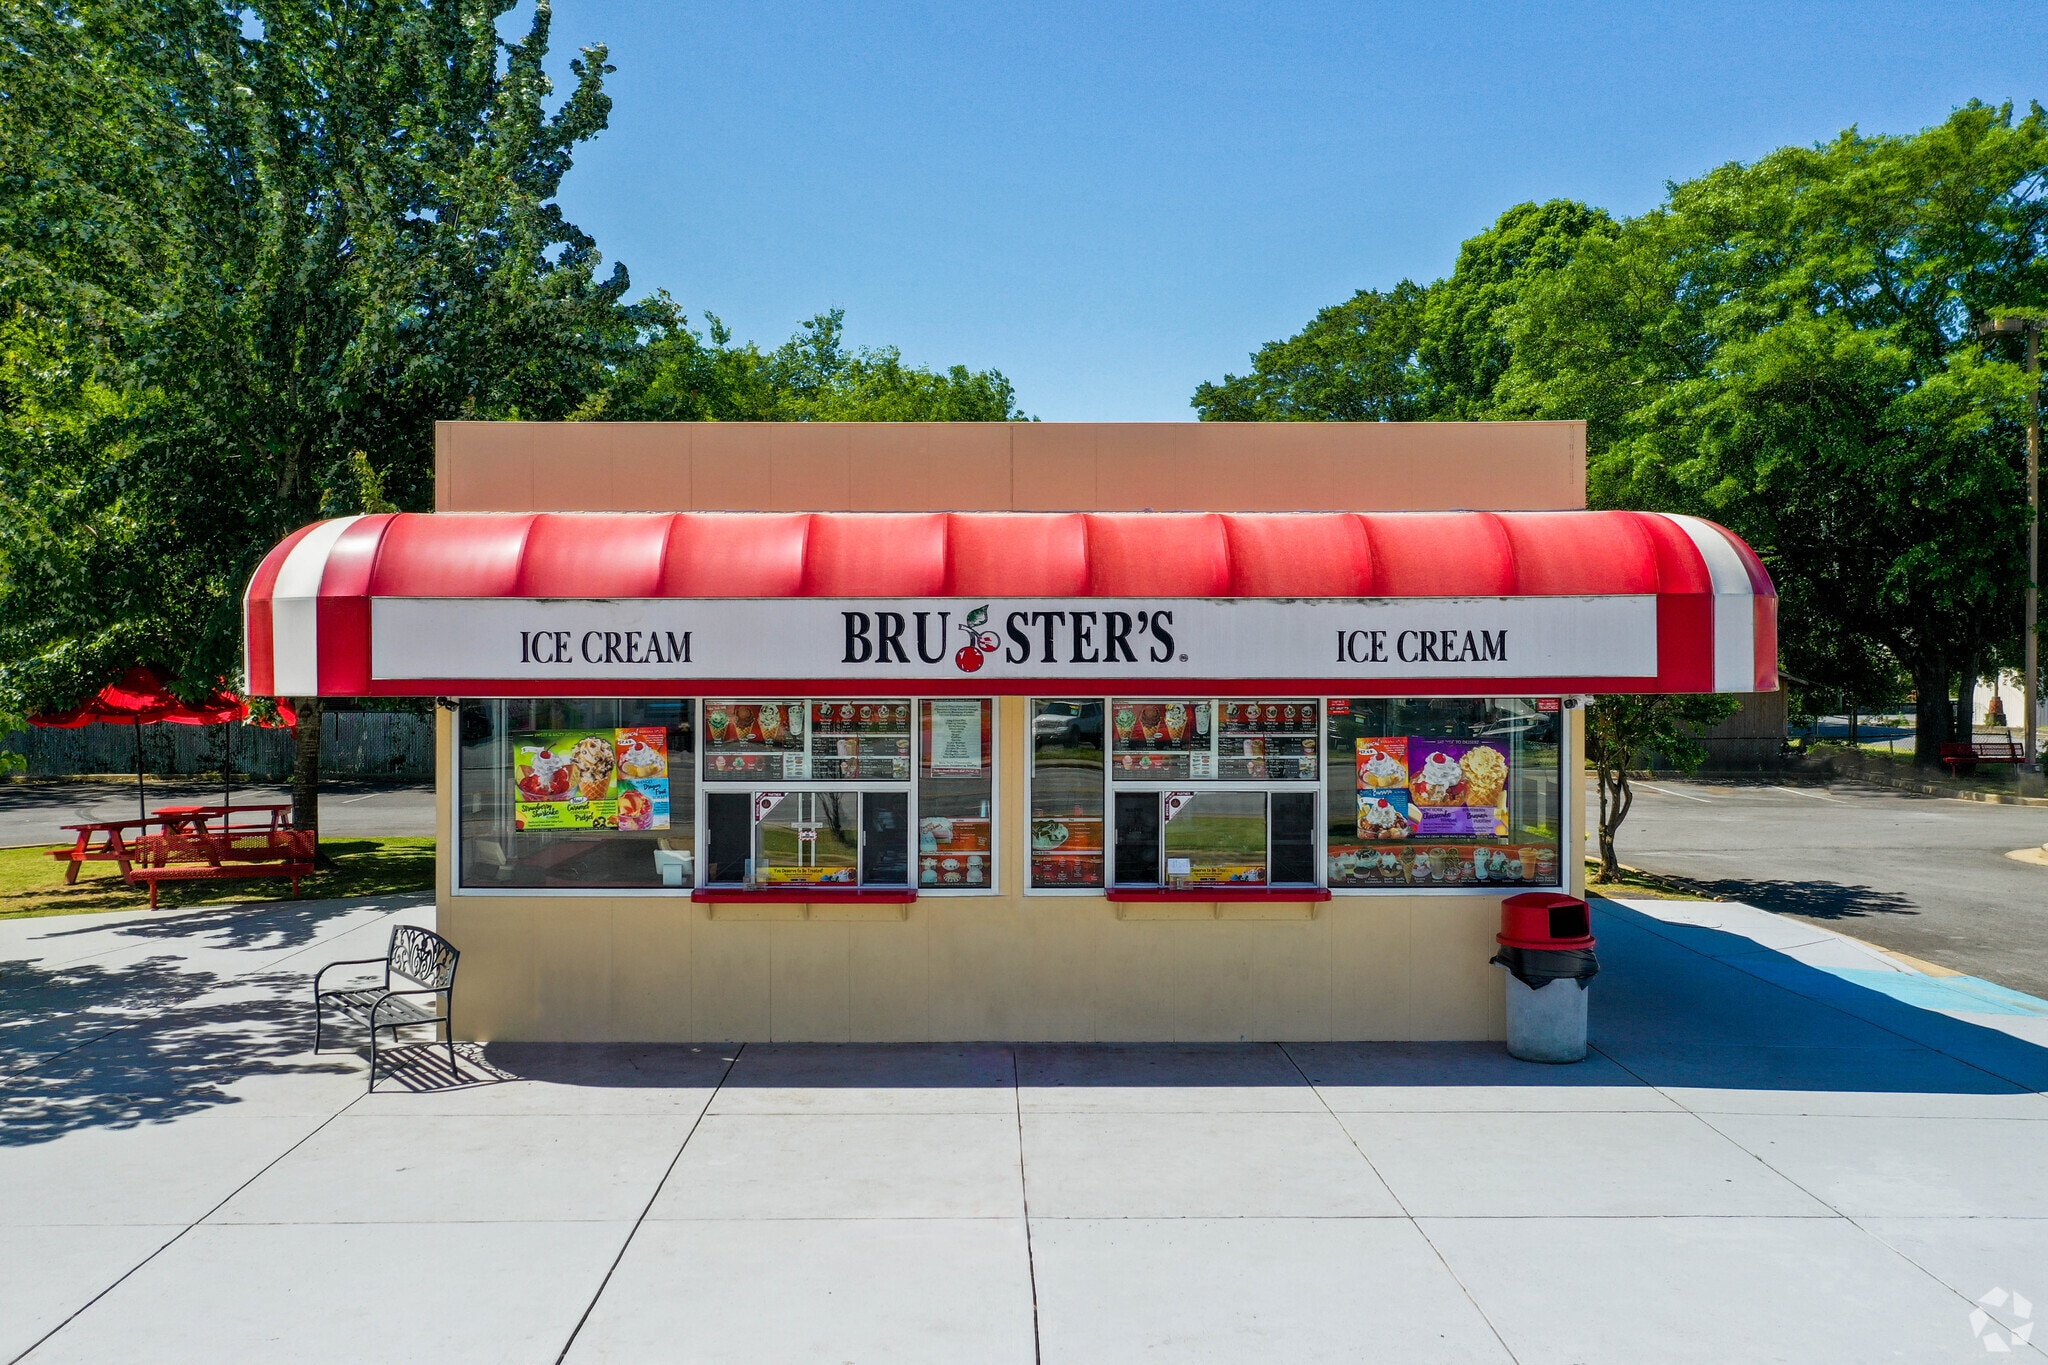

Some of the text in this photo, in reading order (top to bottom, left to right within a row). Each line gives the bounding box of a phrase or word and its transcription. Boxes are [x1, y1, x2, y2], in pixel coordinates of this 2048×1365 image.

[521, 631, 691, 663] ICE CREAM
[1337, 630, 1507, 662] ICE CREAM
